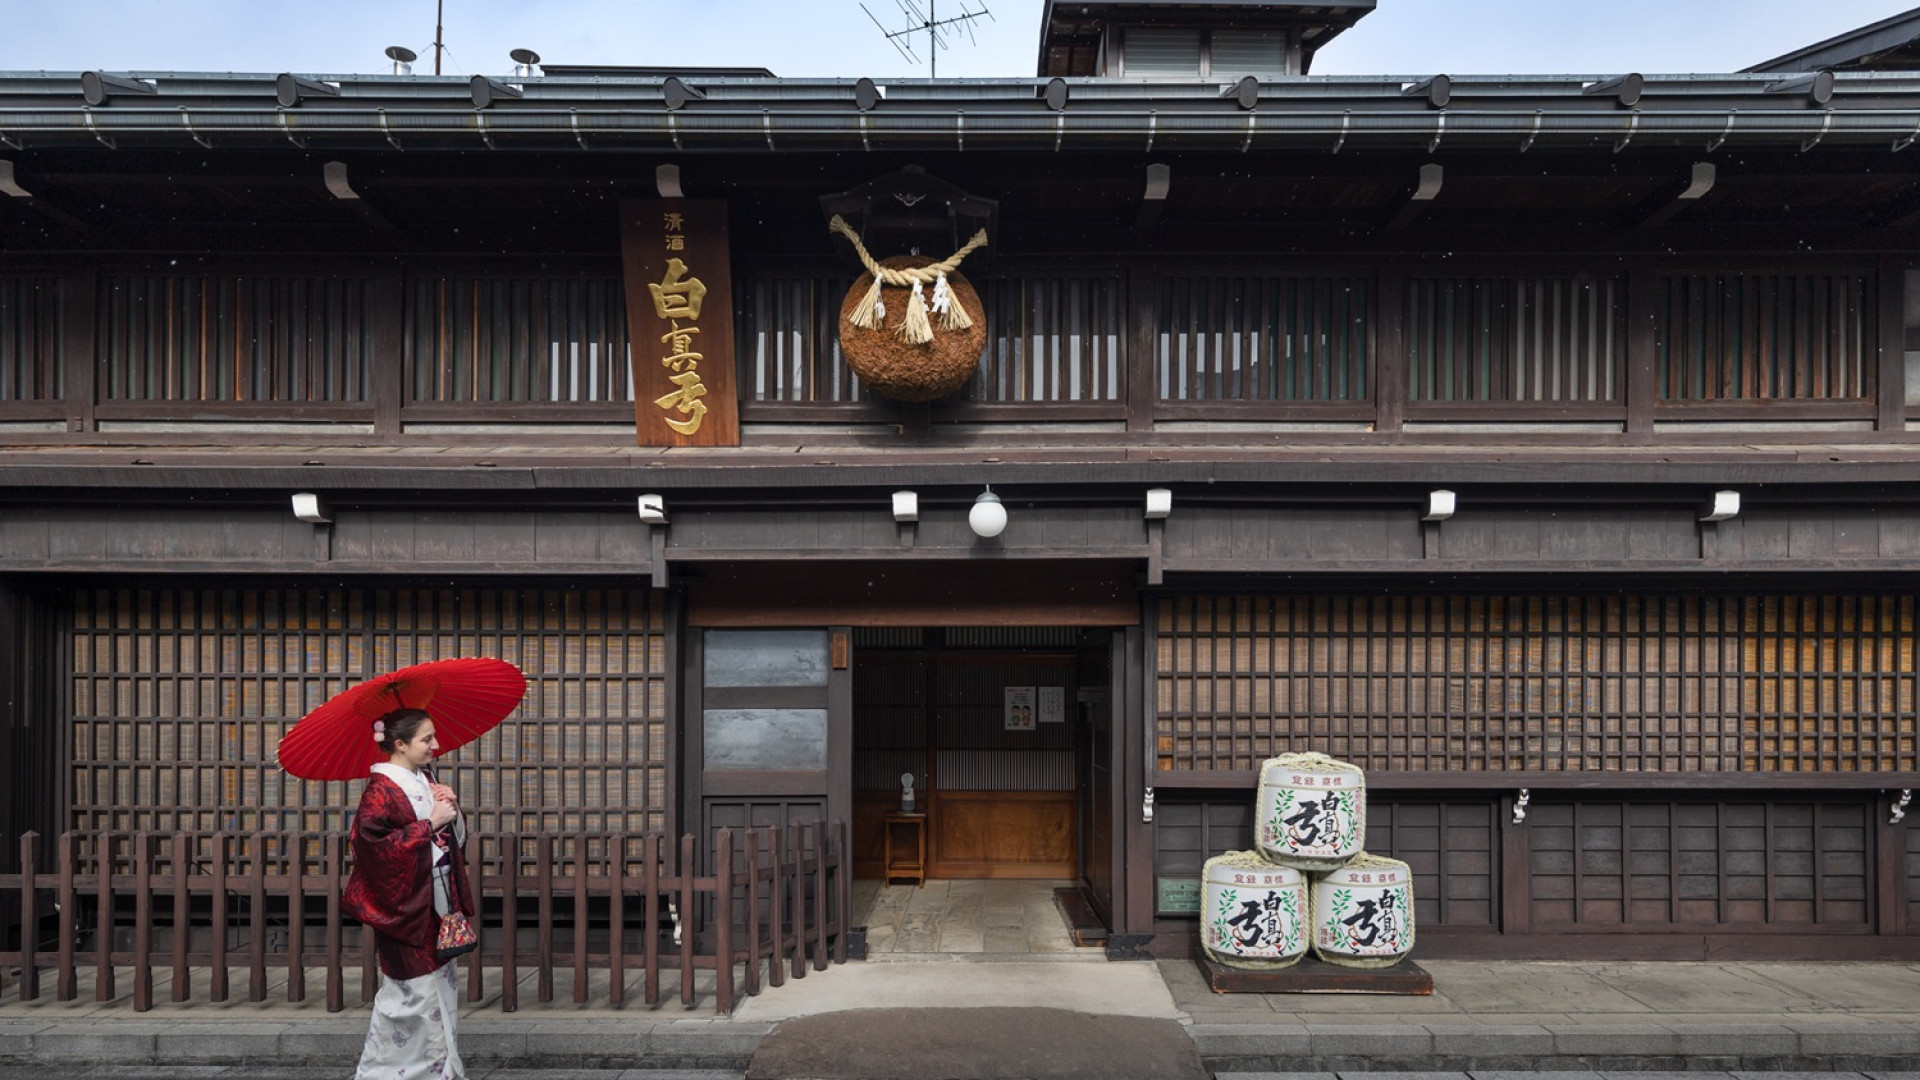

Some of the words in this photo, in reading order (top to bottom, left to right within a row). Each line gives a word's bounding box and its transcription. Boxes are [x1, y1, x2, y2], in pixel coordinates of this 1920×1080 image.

[664, 213, 685, 250] 清酒
[648, 257, 707, 435] 白真弓
